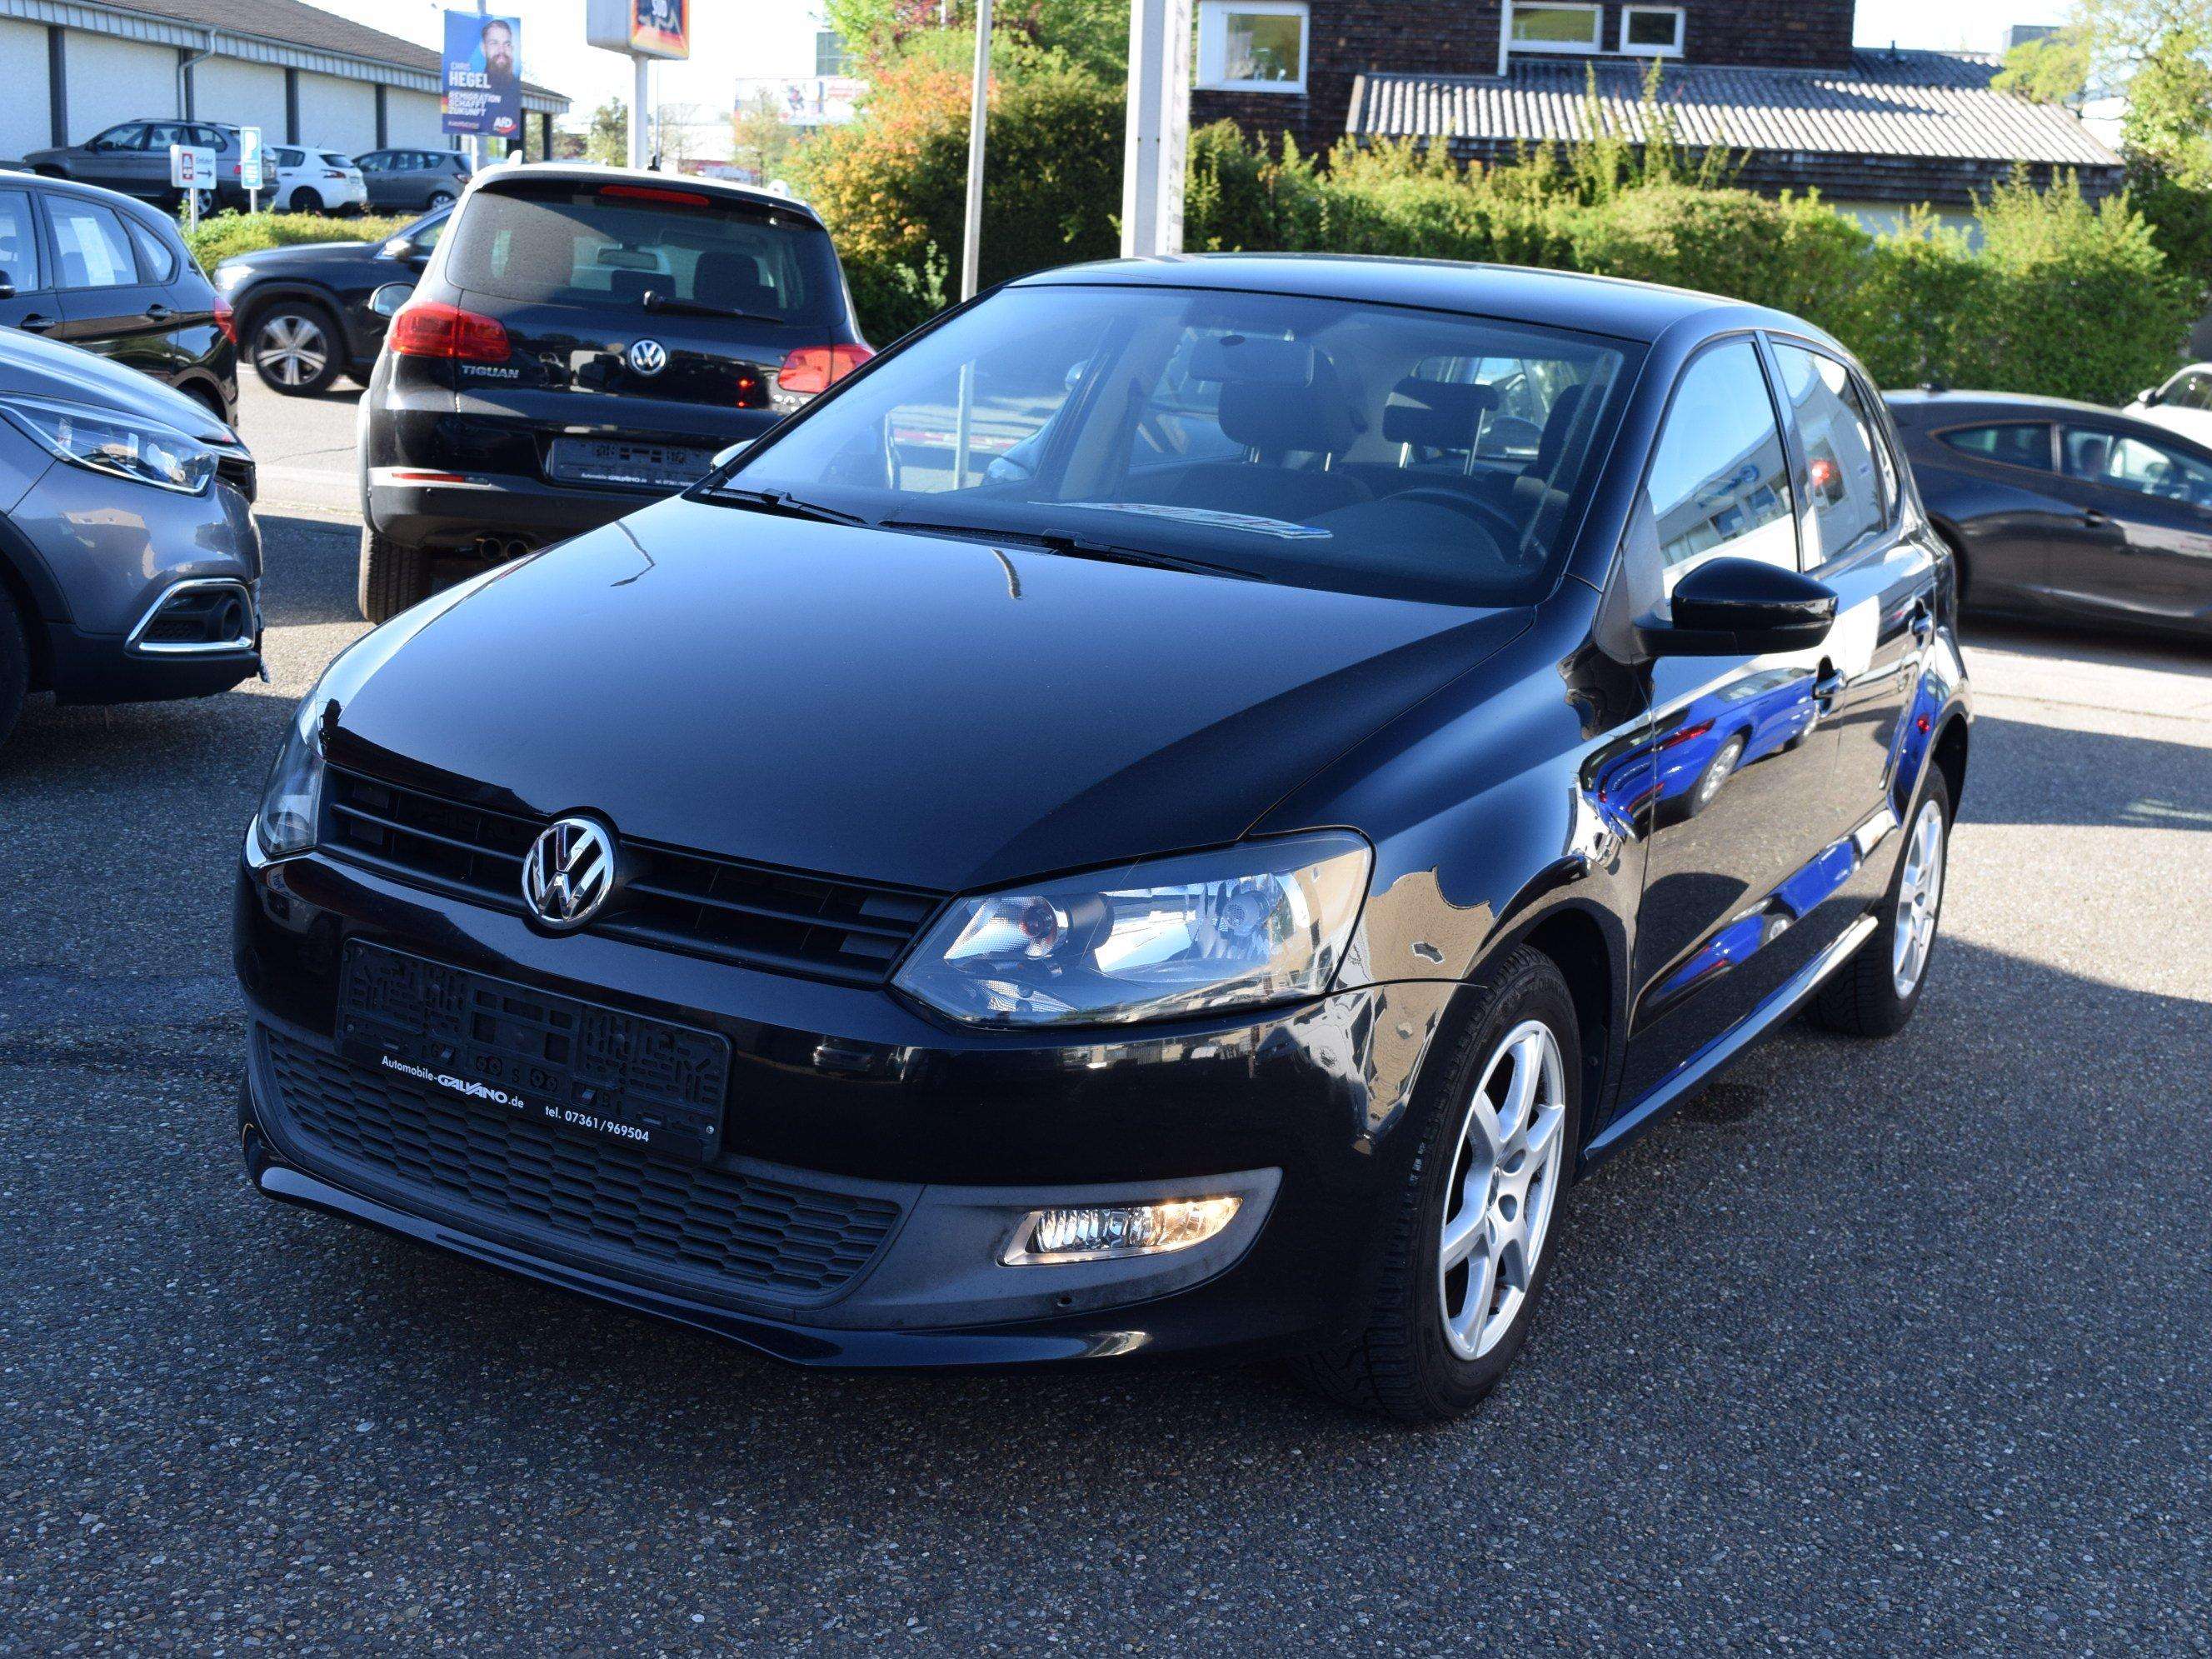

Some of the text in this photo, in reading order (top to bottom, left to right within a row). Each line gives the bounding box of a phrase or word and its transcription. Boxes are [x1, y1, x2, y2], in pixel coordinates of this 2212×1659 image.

[448, 71, 492, 89] HEGEL
[462, 365, 520, 378] TIGUAN
[382, 1056, 650, 1142] Automobile-GALVANO.de tel. 07361/969504
